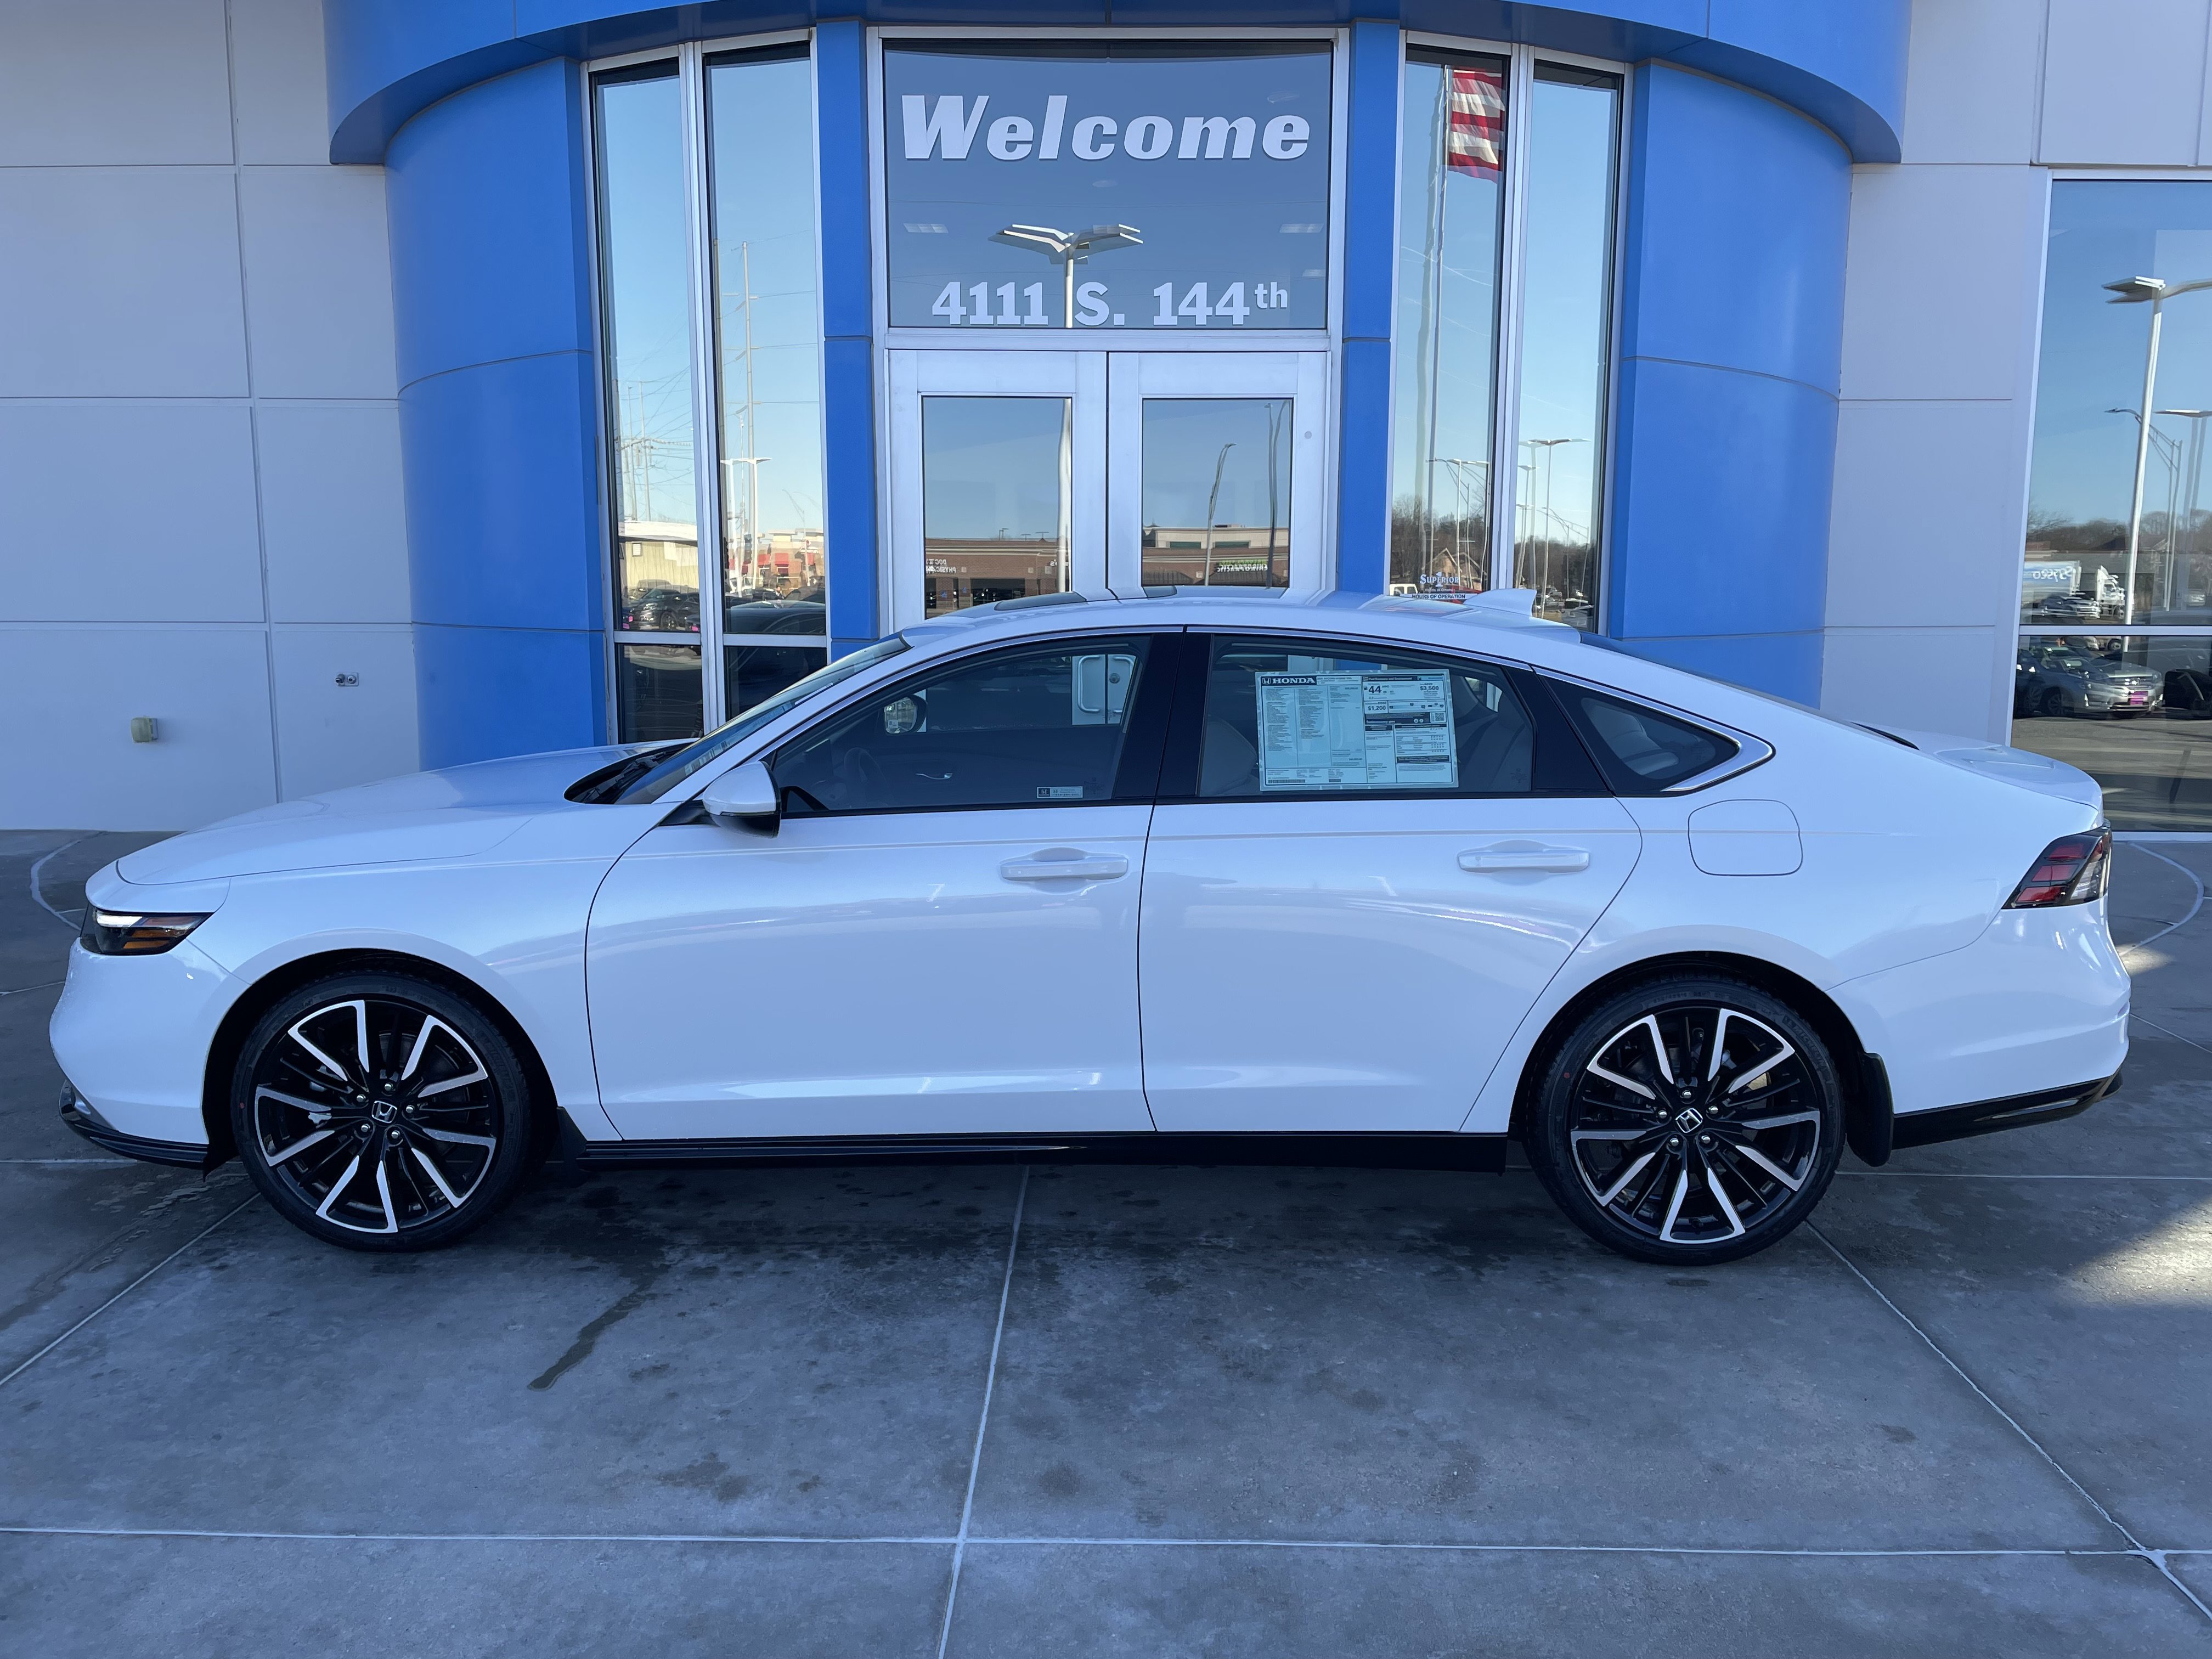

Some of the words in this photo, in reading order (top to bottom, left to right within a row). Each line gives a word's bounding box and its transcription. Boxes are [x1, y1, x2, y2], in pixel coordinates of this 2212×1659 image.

[902, 95, 1310, 160] Welcome
[932, 281, 1048, 325] 4111
[1074, 281, 1126, 326] S.
[1153, 281, 1288, 325] 144th
[1368, 685, 1382, 694] 44
